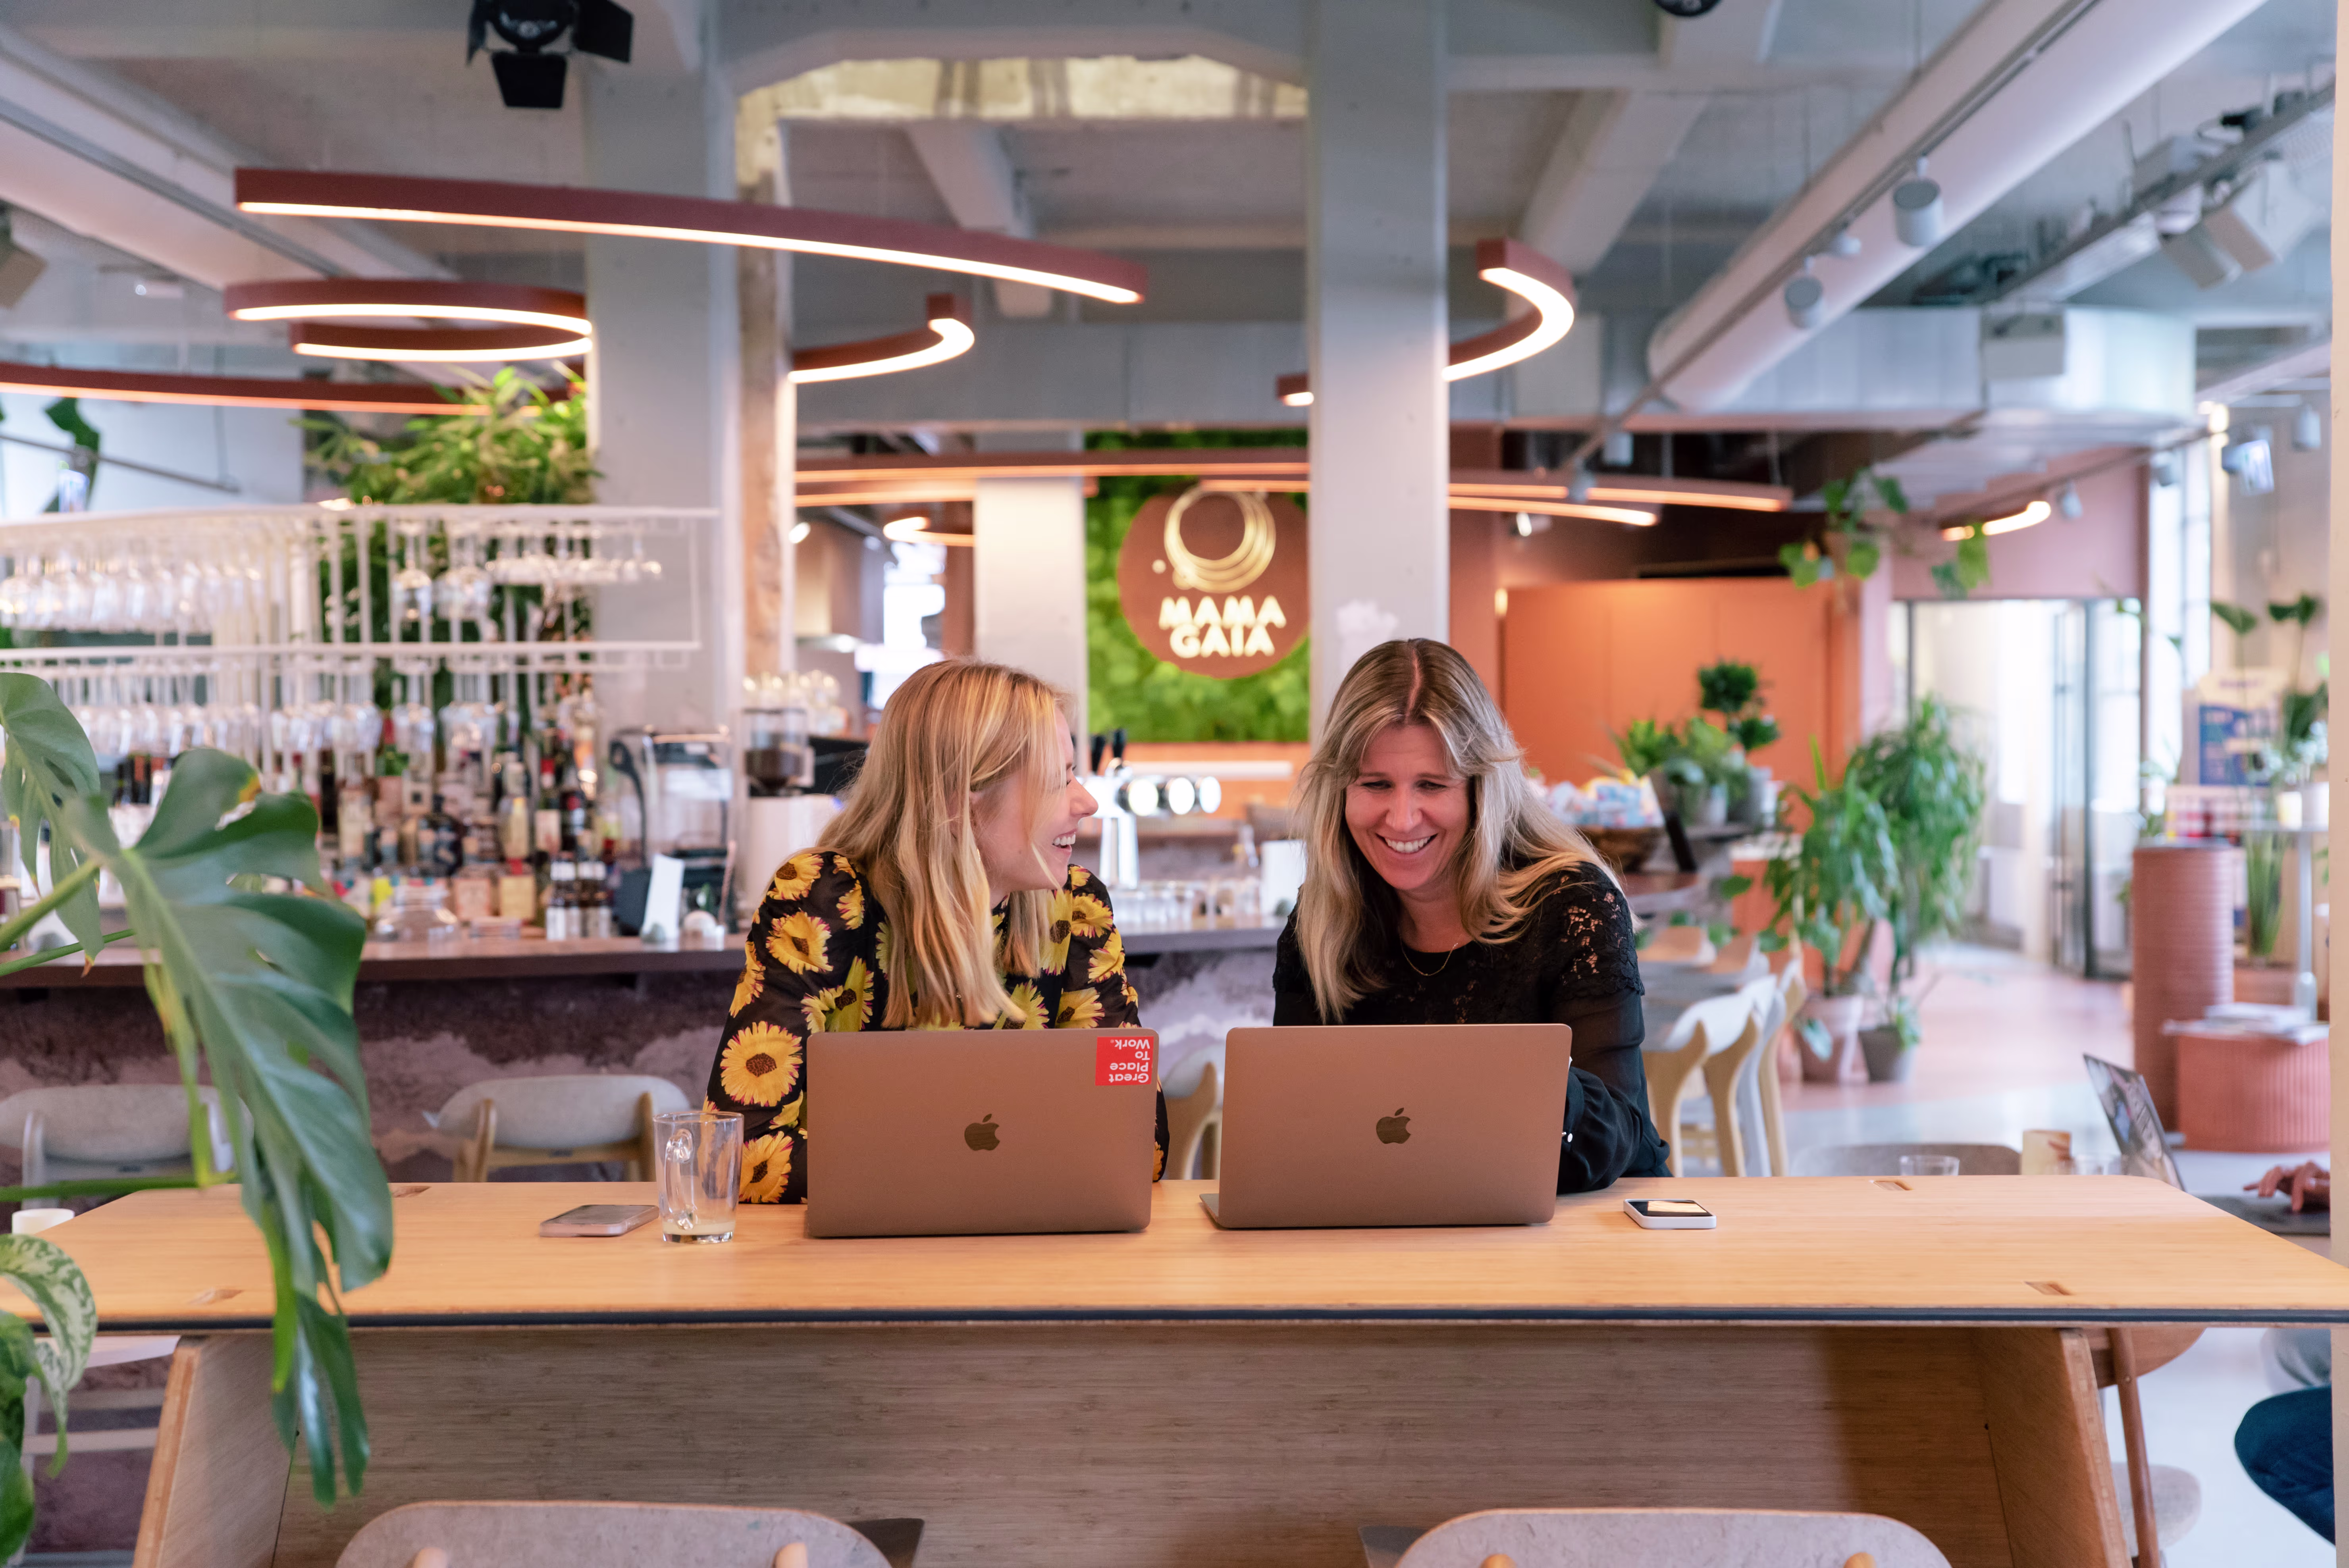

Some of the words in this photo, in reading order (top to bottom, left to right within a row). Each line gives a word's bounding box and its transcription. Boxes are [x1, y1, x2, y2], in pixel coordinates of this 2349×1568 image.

[1158, 595, 1287, 630] MAMA
[1170, 623, 1275, 659] GAIA
[1135, 1051, 1150, 1060] To
[1110, 1062, 1148, 1072] Place
[1109, 1073, 1149, 1083] Great
